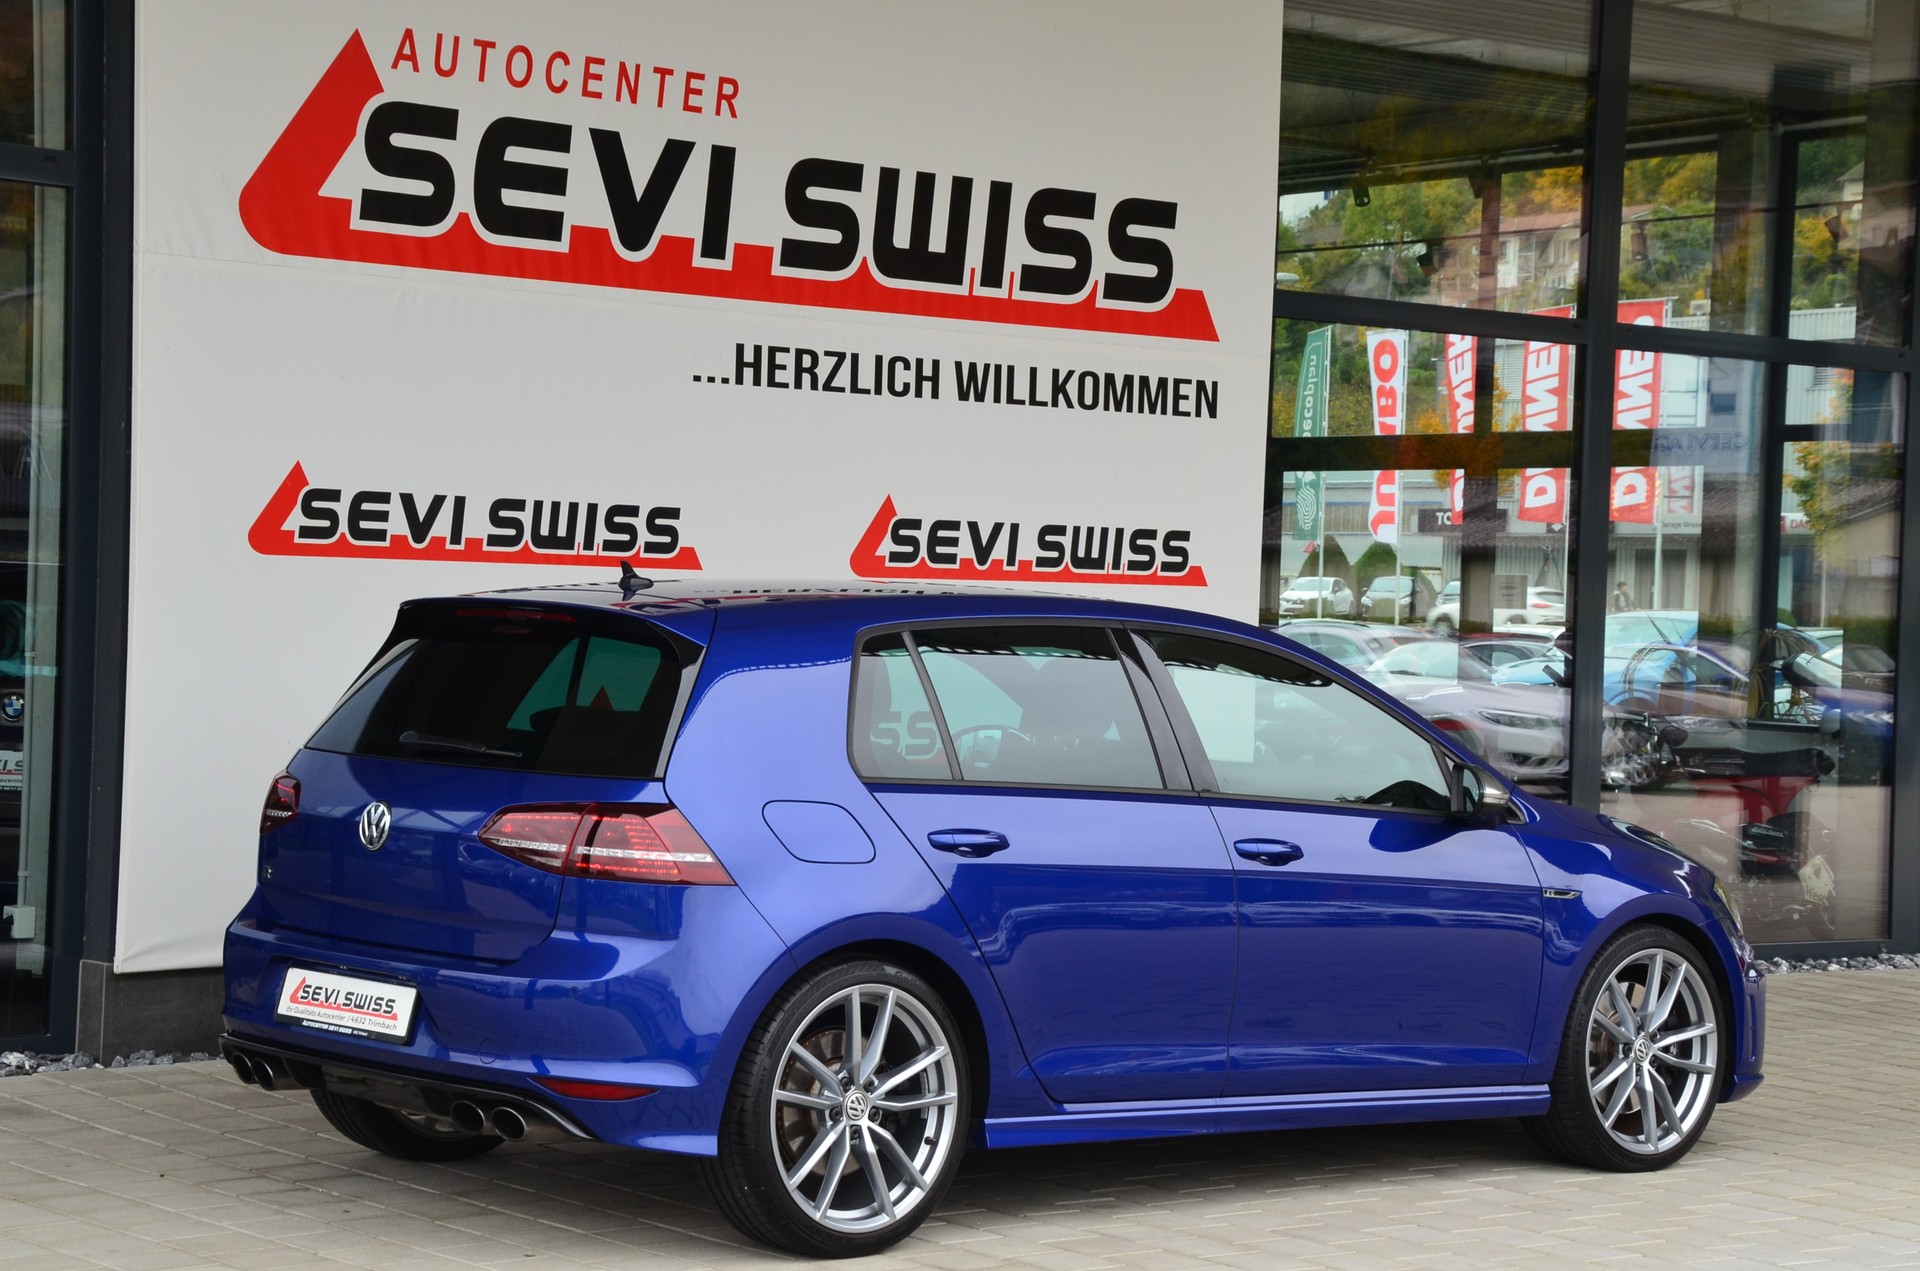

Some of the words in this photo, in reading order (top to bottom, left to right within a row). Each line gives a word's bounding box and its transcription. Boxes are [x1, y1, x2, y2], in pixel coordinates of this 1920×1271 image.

[391, 28, 740, 119] AUTOCENTER
[360, 101, 736, 260] SEVI
[780, 158, 1177, 304] SWISS
[693, 343, 940, 400] ...HERZLICH
[955, 361, 1219, 419] WILLKOMMEN
[299, 489, 466, 546] SEVI
[487, 499, 680, 555] SWISS
[889, 519, 1019, 567] SEVI
[1036, 525, 1190, 573] SWISS
[300, 984, 341, 1005] SEVI
[342, 992, 396, 1015] SWISS
[316, 1010, 345, 1021] Autocenter
[351, 1015, 367, 1025] 4632
[368, 1019, 397, 1031] Trimbach
